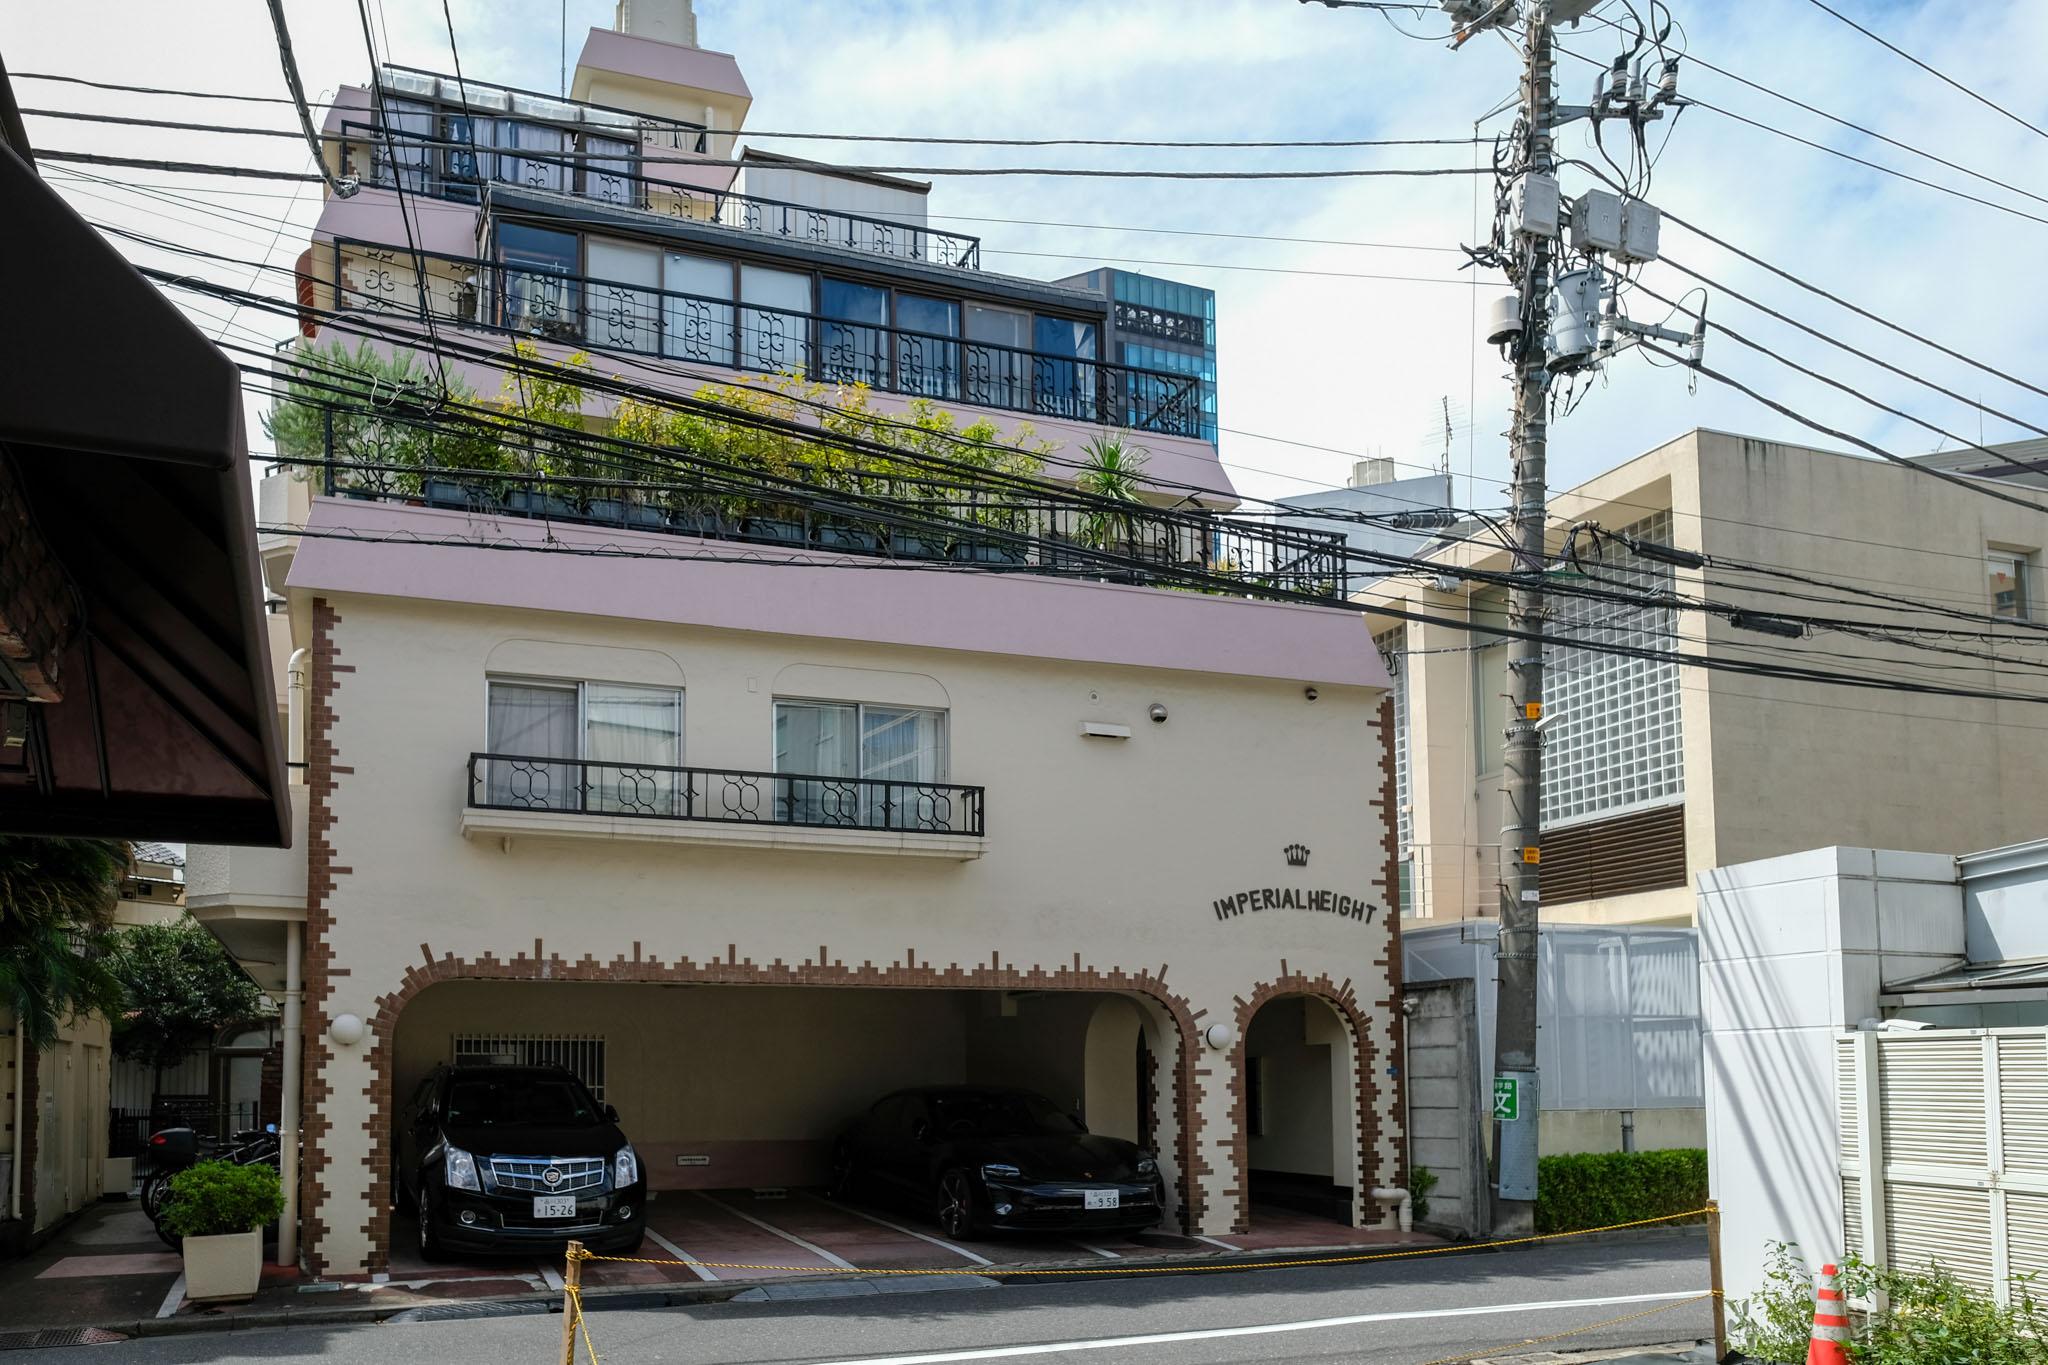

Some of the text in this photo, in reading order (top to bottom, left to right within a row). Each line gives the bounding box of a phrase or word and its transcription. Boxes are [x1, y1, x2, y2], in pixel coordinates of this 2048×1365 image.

[1213, 888, 1377, 925] IMPERIALHEIGHT
[1494, 1090, 1512, 1113] 文
[544, 1204, 573, 1216] 15-26
